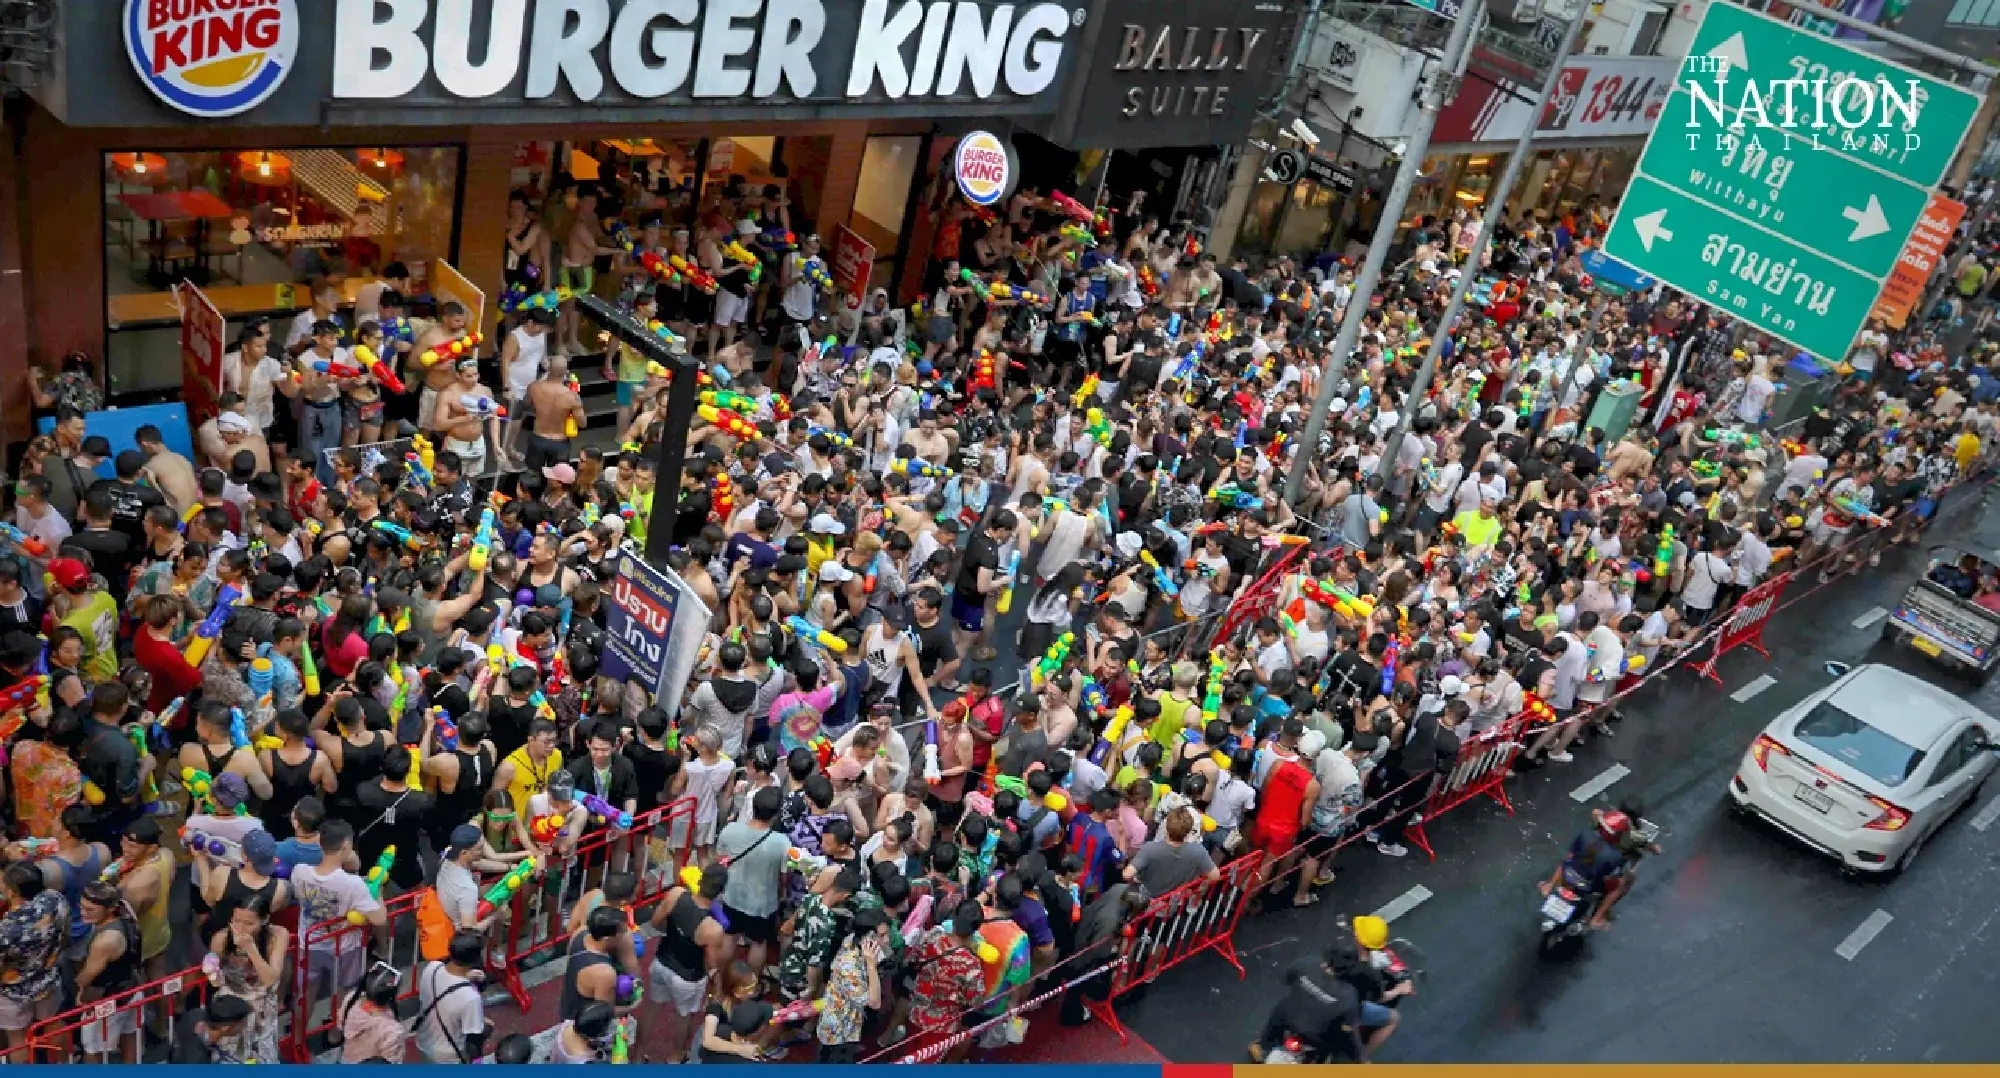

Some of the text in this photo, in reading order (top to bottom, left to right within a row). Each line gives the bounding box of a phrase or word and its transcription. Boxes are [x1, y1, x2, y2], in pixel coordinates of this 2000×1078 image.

[153, 8, 281, 76] KING
[333, 0, 1070, 102] BURGER KING
[1113, 23, 1267, 71] BALLY
[1121, 86, 1230, 117] SUITE
[1580, 74, 1656, 123] 1344
[960, 160, 1004, 184] KING
[962, 147, 1004, 166] BURGER
[1688, 168, 1785, 223] Witthayu
[1701, 233, 1836, 317] สามย่าน
[1706, 279, 1796, 332] Sam Yan
[615, 582, 668, 634] ปราบ
[625, 614, 662, 662] โกง
